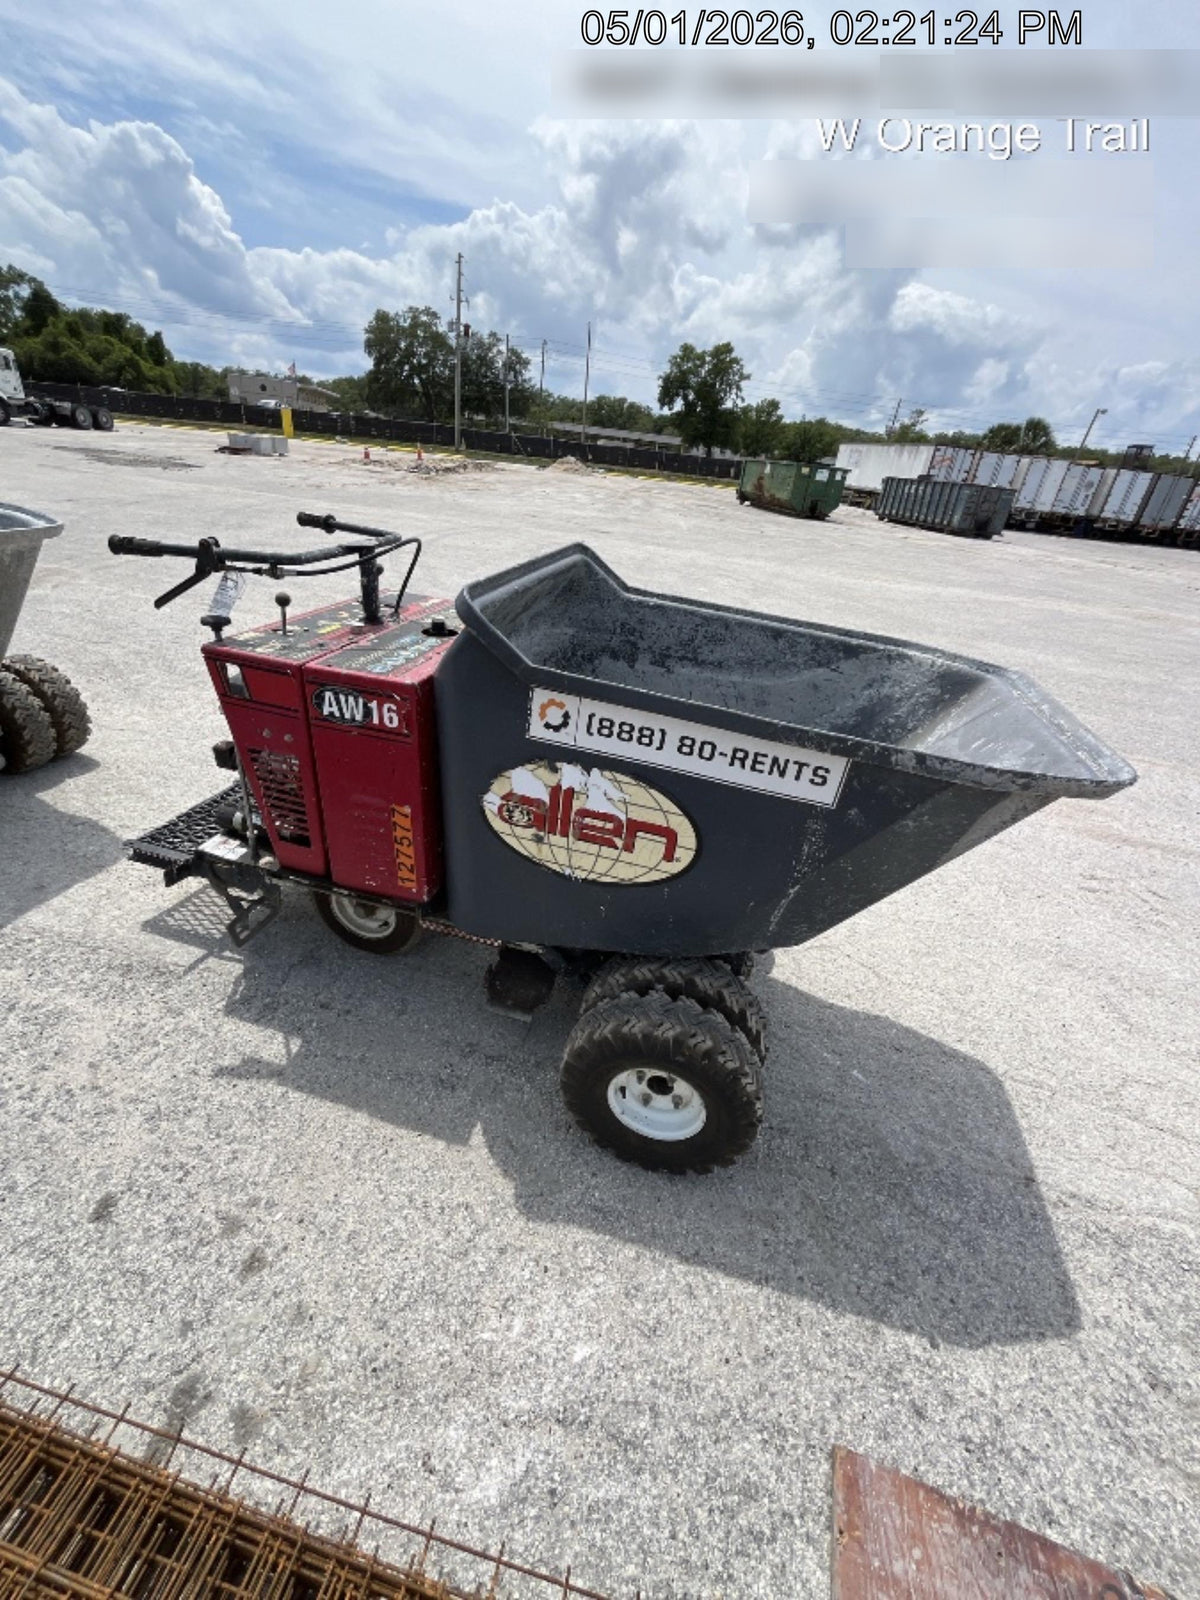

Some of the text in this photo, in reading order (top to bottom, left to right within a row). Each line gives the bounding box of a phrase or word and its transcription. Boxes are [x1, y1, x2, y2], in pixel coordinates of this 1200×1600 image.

[586, 712, 832, 787] (888) 80-RENTS
[392, 807, 415, 888] 127577
